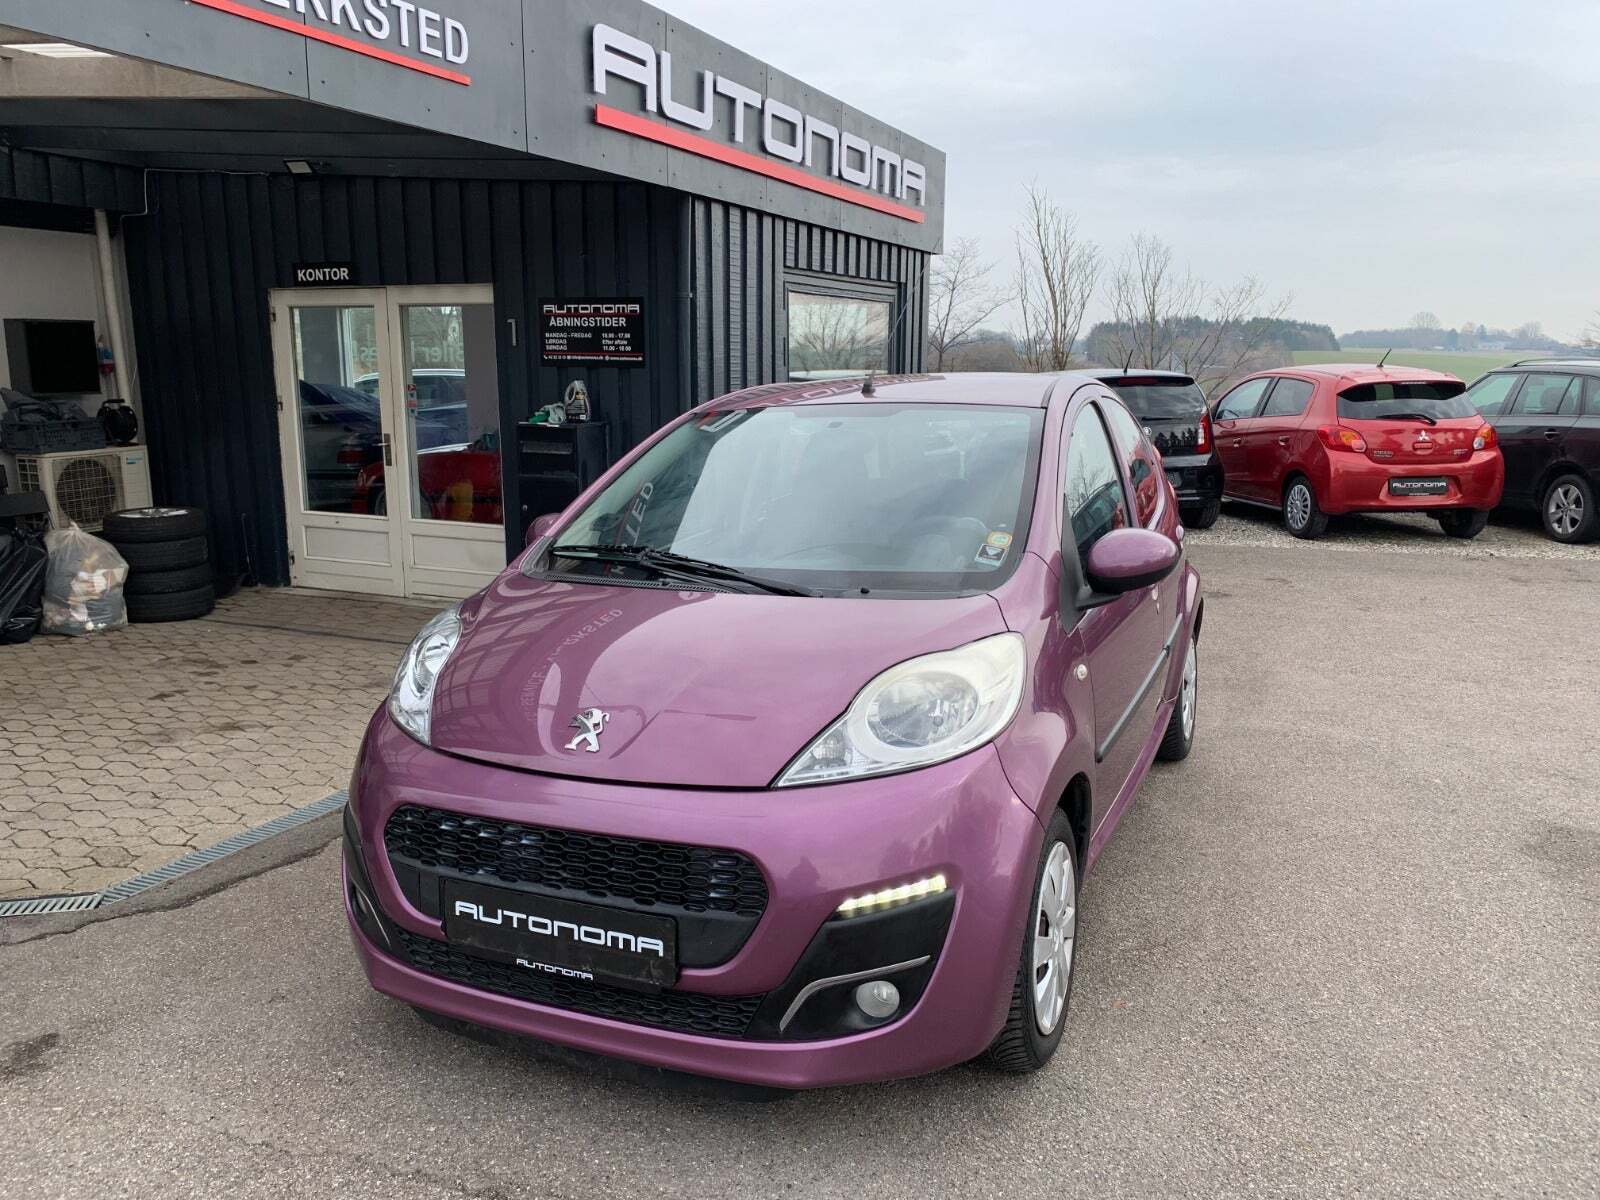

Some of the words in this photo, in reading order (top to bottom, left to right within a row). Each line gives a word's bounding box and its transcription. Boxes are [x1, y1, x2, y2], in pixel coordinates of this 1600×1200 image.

[592, 23, 926, 206] AUTONOMA
[297, 268, 349, 281] KONTOR
[543, 304, 640, 314] AUTONOMA
[549, 316, 626, 327] ÅBNINGSTIDER
[455, 901, 664, 957] AUTONOMA
[516, 958, 594, 981] AUTONOMA
